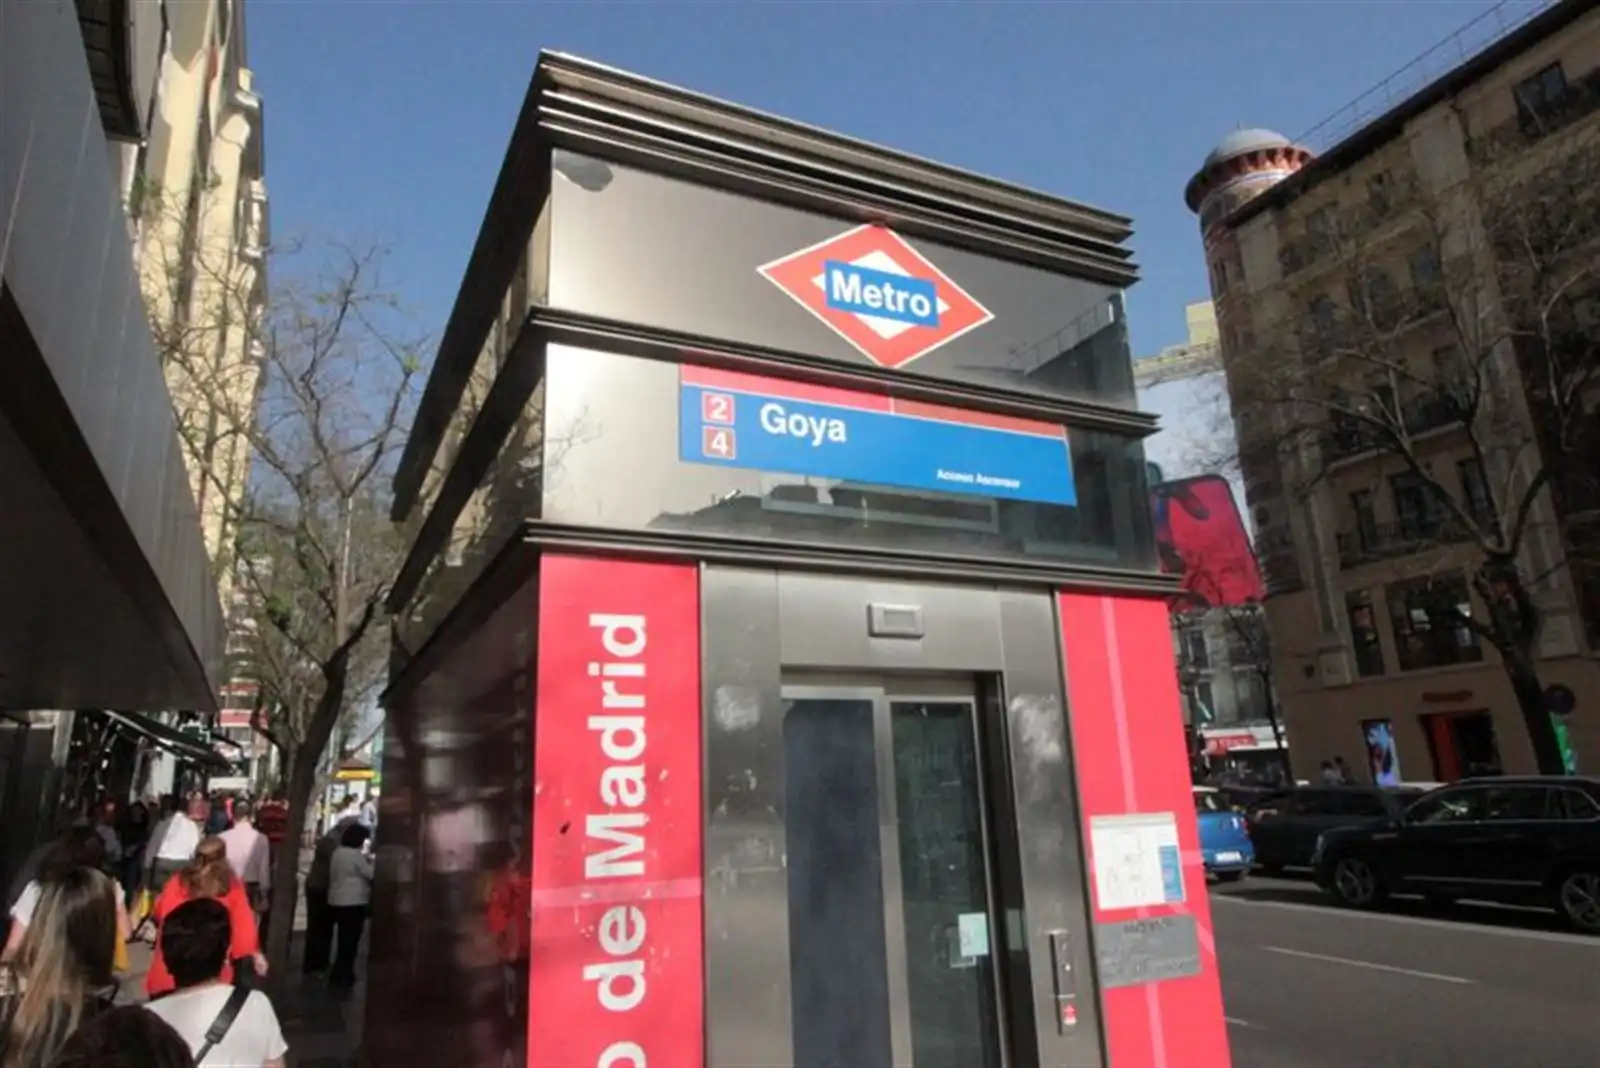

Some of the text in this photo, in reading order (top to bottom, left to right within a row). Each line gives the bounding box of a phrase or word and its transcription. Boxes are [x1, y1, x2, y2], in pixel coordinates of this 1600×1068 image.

[831, 268, 931, 318] Metro
[708, 396, 729, 420] 2
[760, 403, 847, 447] Goya
[710, 431, 730, 456] 4
[585, 613, 647, 879] Madrid
[582, 904, 647, 1012] de
